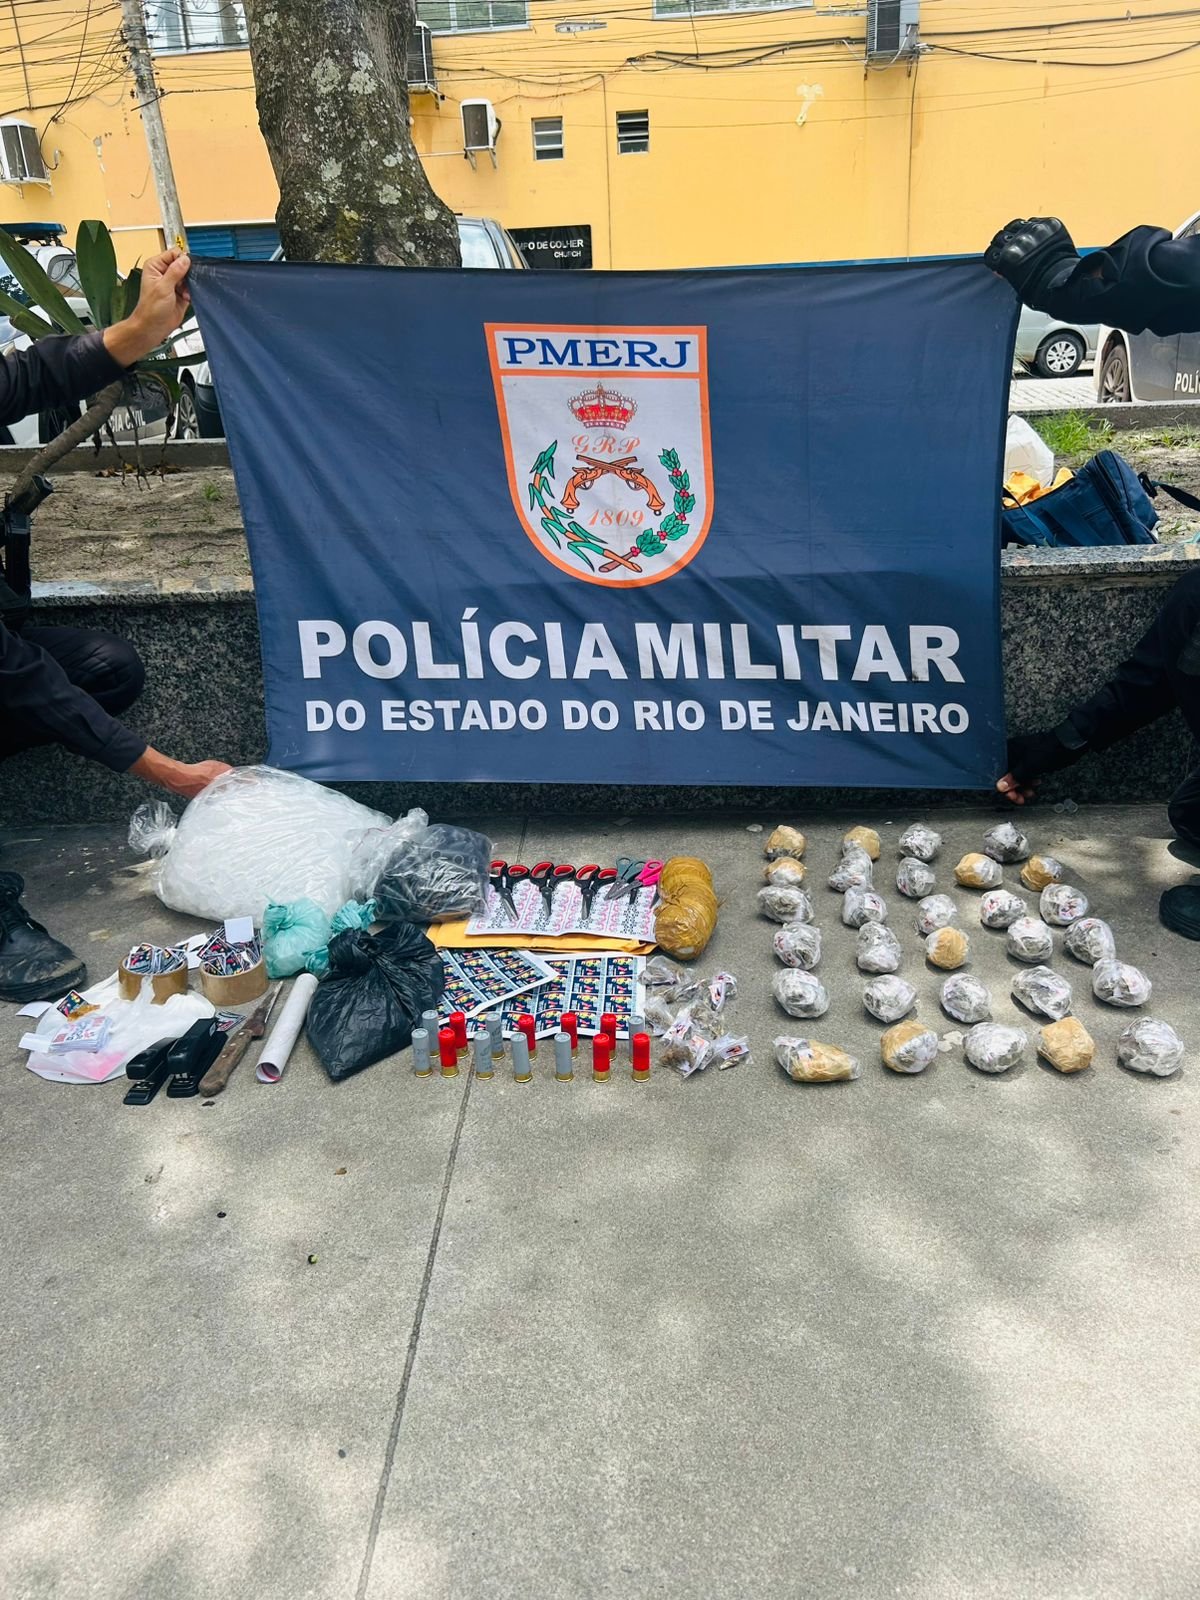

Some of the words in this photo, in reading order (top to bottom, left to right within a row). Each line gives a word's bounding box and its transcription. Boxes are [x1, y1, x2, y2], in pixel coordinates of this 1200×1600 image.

[517, 242, 535, 250] MPO
[536, 241, 549, 250] DE
[503, 337, 691, 369] PMERJ
[1174, 370, 1200, 394] POLÍ
[588, 508, 646, 527] 1809
[298, 607, 629, 680] POLÍCIA
[634, 622, 966, 683] MILITAR
[305, 700, 366, 732] DO
[381, 699, 548, 731] ESTADO
[561, 699, 619, 730] DO
[633, 700, 706, 731] RIO
[719, 700, 775, 730] DE
[786, 700, 970, 734] JANEIRO
